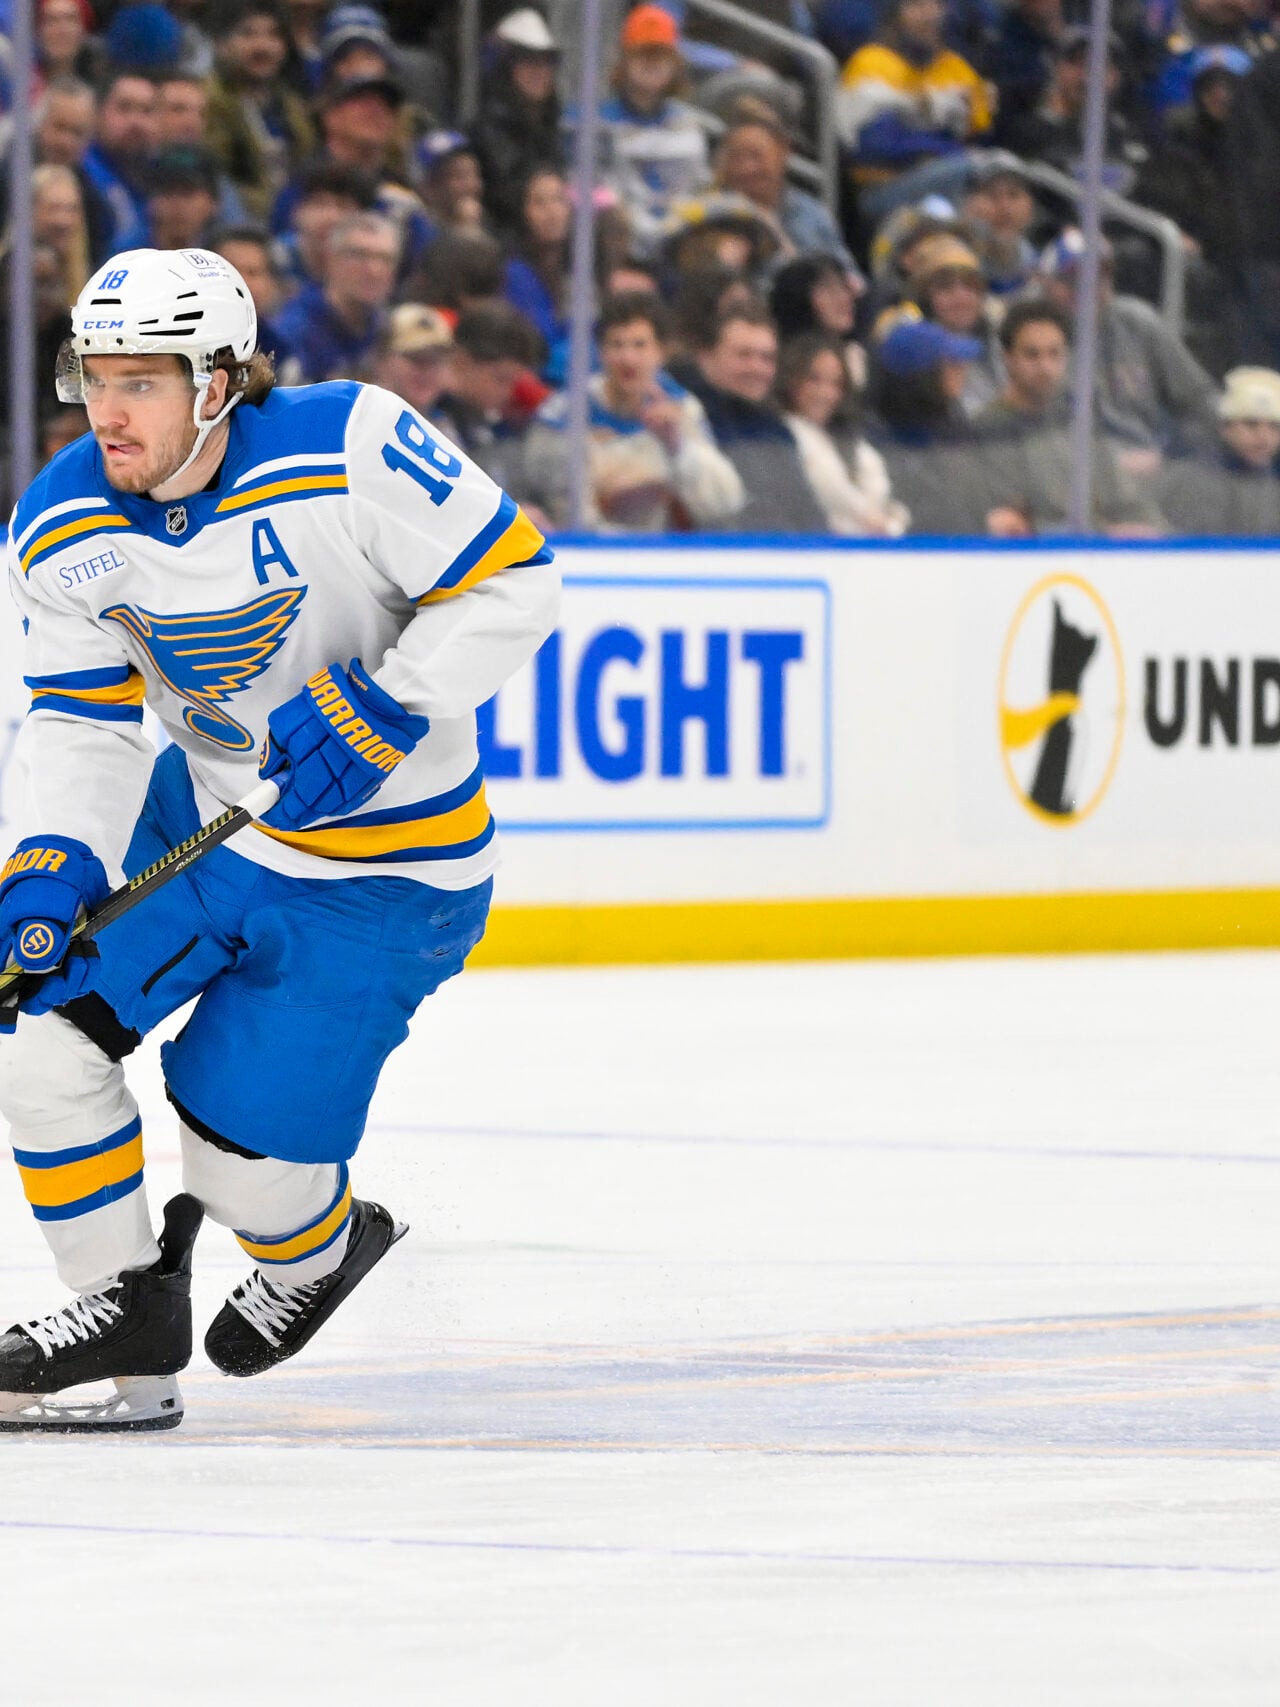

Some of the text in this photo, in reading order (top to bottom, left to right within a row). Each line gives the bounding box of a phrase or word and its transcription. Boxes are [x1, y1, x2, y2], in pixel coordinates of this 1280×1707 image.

[98, 269, 129, 290] 18
[83, 320, 124, 329] CCM
[381, 409, 462, 507] 18
[59, 550, 125, 589] STIFEL
[252, 517, 299, 585] A
[475, 623, 804, 783] LIGHT
[1143, 655, 1280, 750] UND
